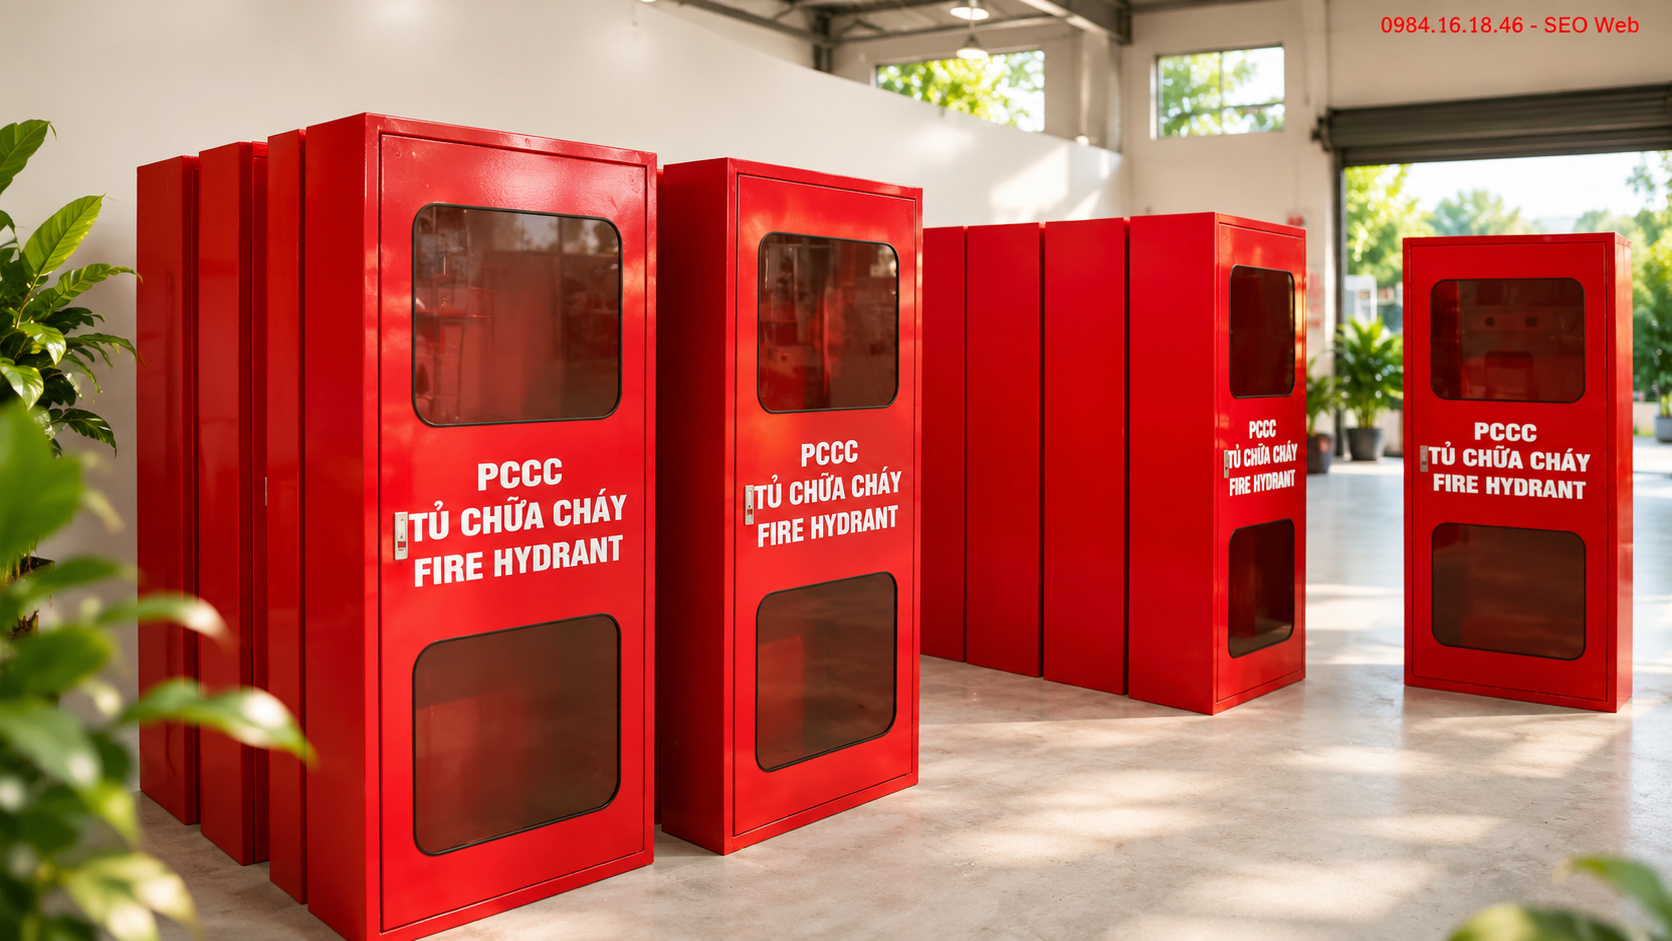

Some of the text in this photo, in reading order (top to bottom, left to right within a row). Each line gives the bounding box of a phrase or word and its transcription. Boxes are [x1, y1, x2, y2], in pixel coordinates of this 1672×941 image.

[1249, 419, 1277, 439] PCCC
[1474, 422, 1537, 442] PCCC
[801, 440, 859, 467] PCCC
[1273, 439, 1298, 463] CHÁY
[1428, 441, 1591, 472] TỦ CHỮA CHÁY
[477, 458, 563, 492] PCCC
[754, 466, 902, 510] TỦ CHỮA CHÁY
[1229, 469, 1296, 497] FIRE HYDRANT
[1433, 473, 1587, 500] FIRE HYDRANT
[408, 488, 628, 542] TỦ CHỮA CHÁY
[758, 505, 899, 548] FIRE HYDRANT
[414, 535, 624, 588] FIRE HYDRANT
